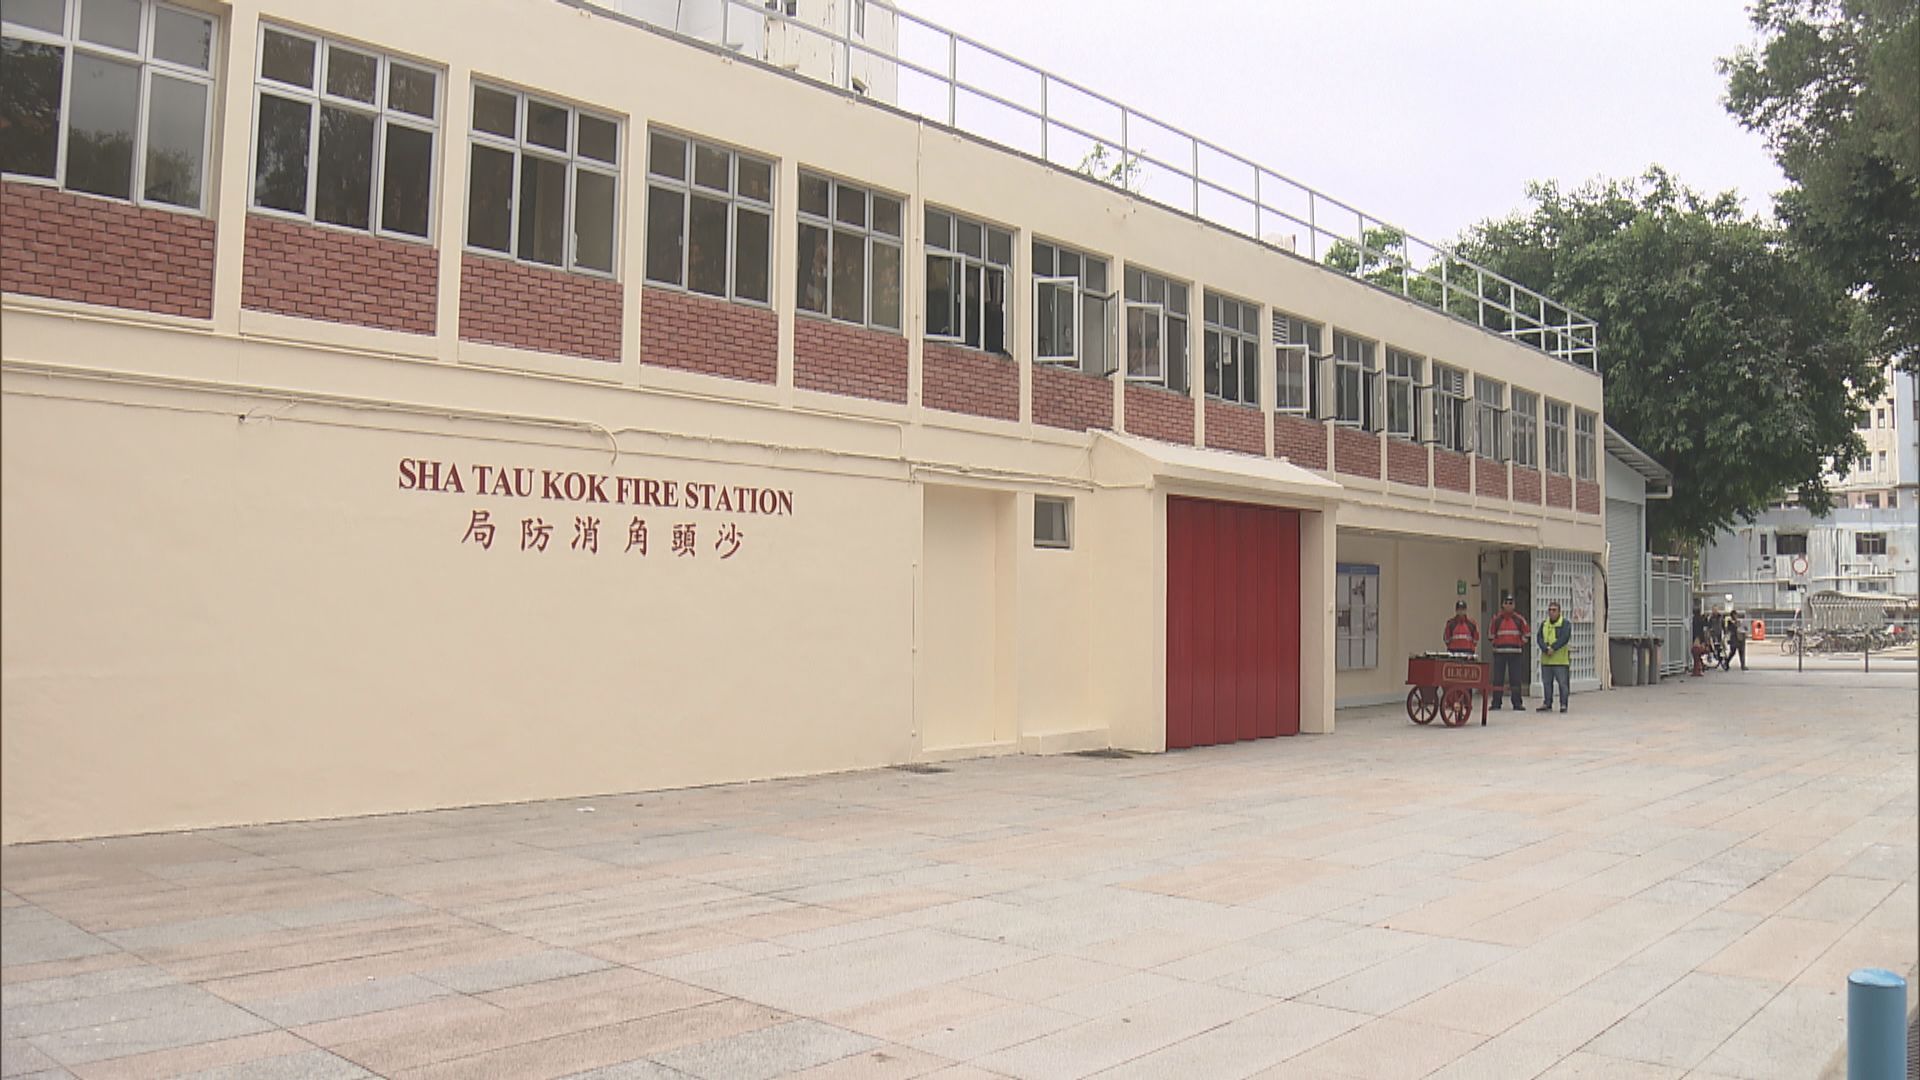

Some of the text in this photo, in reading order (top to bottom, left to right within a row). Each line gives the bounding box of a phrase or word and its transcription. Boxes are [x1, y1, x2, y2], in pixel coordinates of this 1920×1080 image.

[398, 458, 793, 515] SHA TAU KOK FIRE STATION
